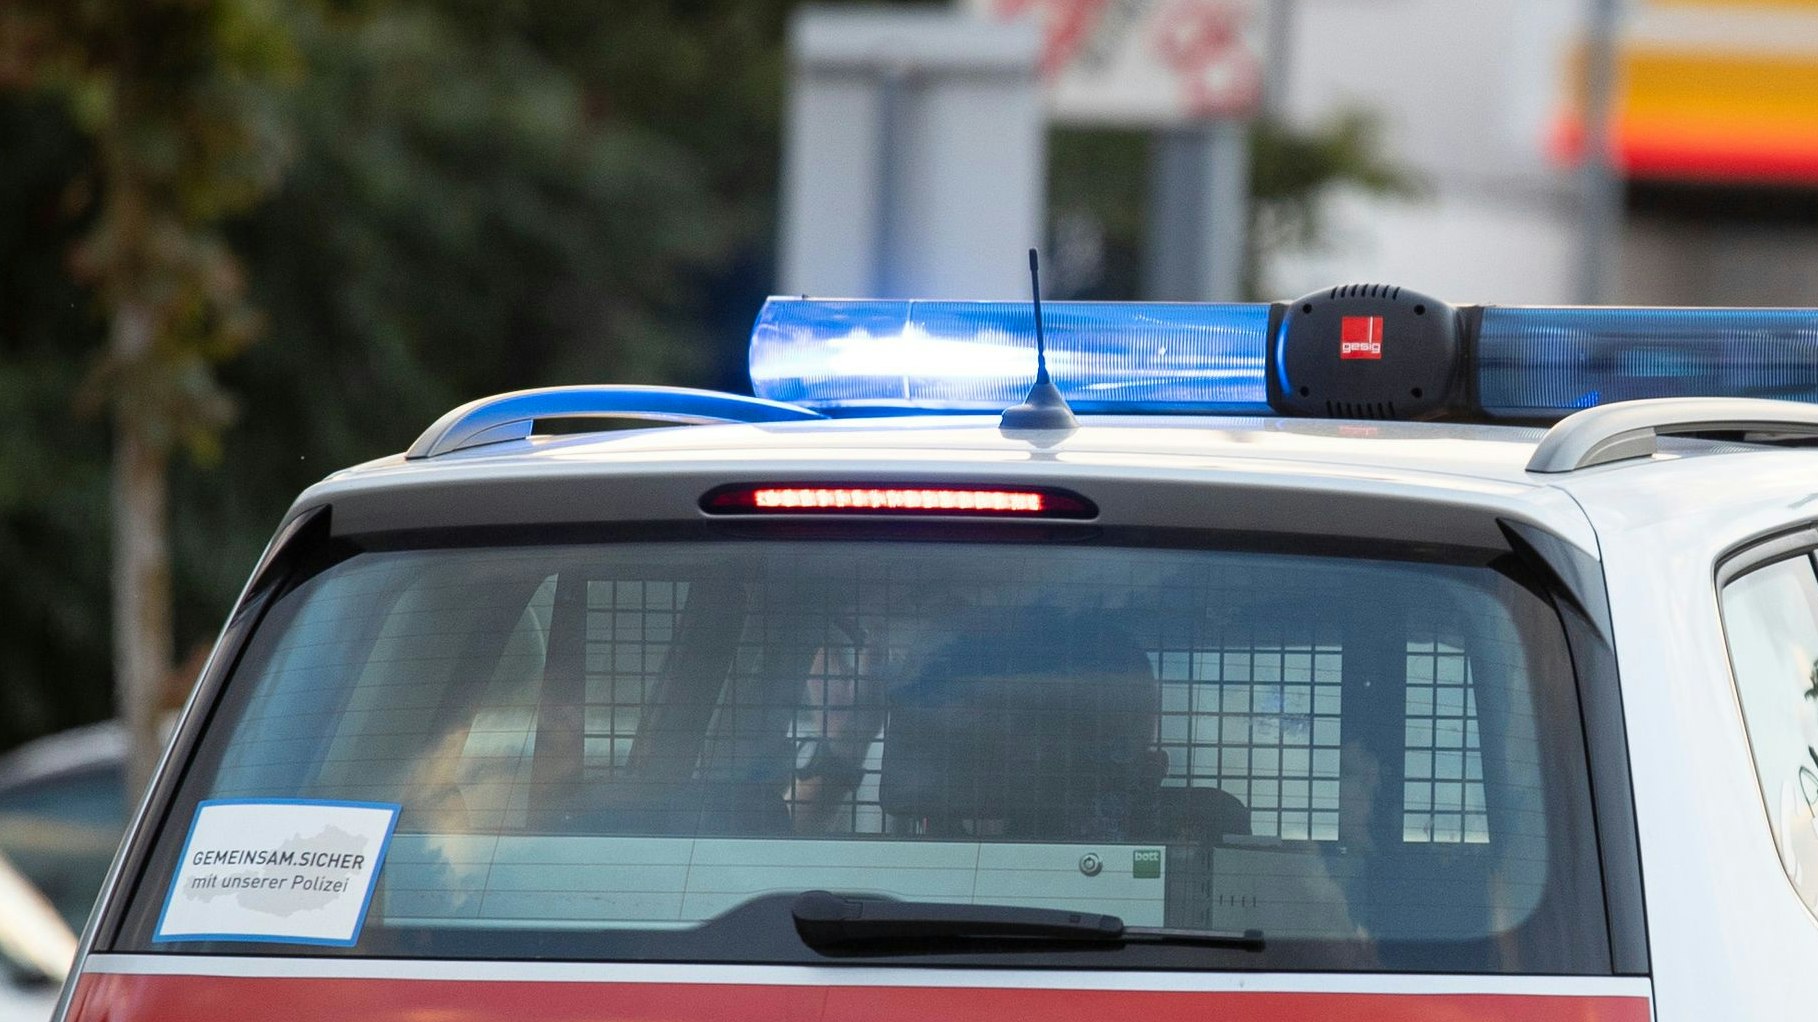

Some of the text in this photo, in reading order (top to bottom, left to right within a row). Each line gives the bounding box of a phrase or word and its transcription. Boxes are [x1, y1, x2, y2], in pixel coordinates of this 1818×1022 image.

[192, 850, 365, 870] GEMEINSAM.SICHER
[1135, 851, 1160, 861] bott
[191, 873, 349, 892] mit unserer Polizei
